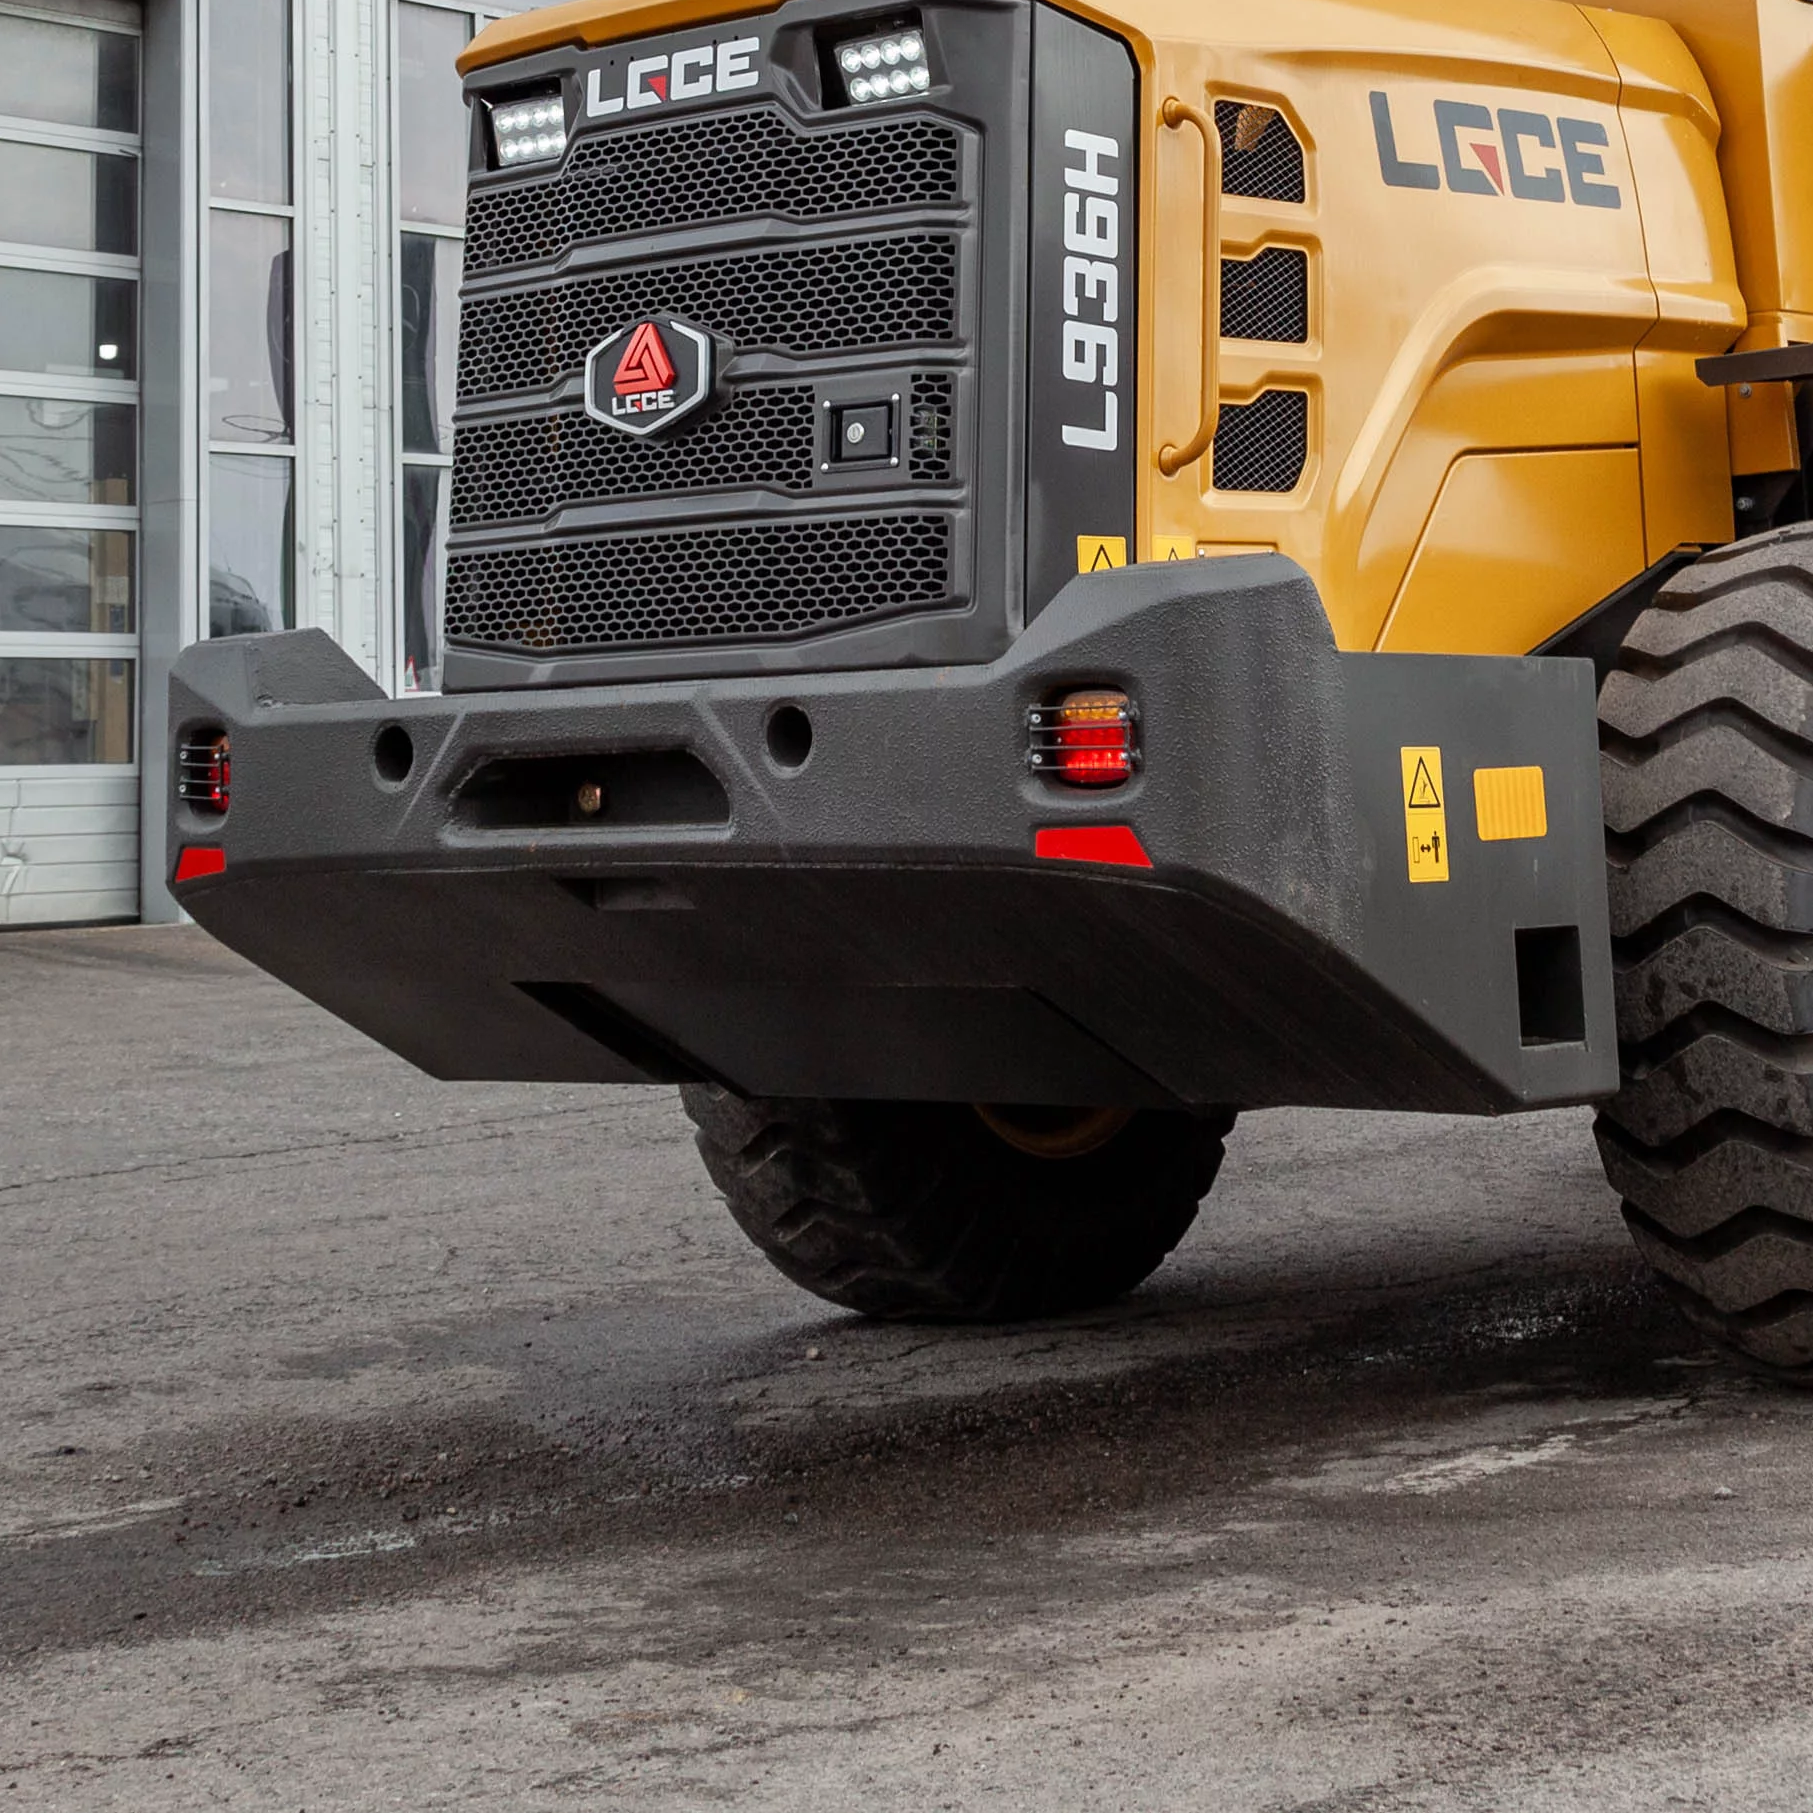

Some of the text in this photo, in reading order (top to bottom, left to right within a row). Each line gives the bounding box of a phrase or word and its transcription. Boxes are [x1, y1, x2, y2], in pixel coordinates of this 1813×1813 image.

[587, 37, 760, 118] LGCE
[1368, 90, 1622, 210] LGCE
[1062, 129, 1119, 452] L936H
[611, 389, 676, 416] LGCE
